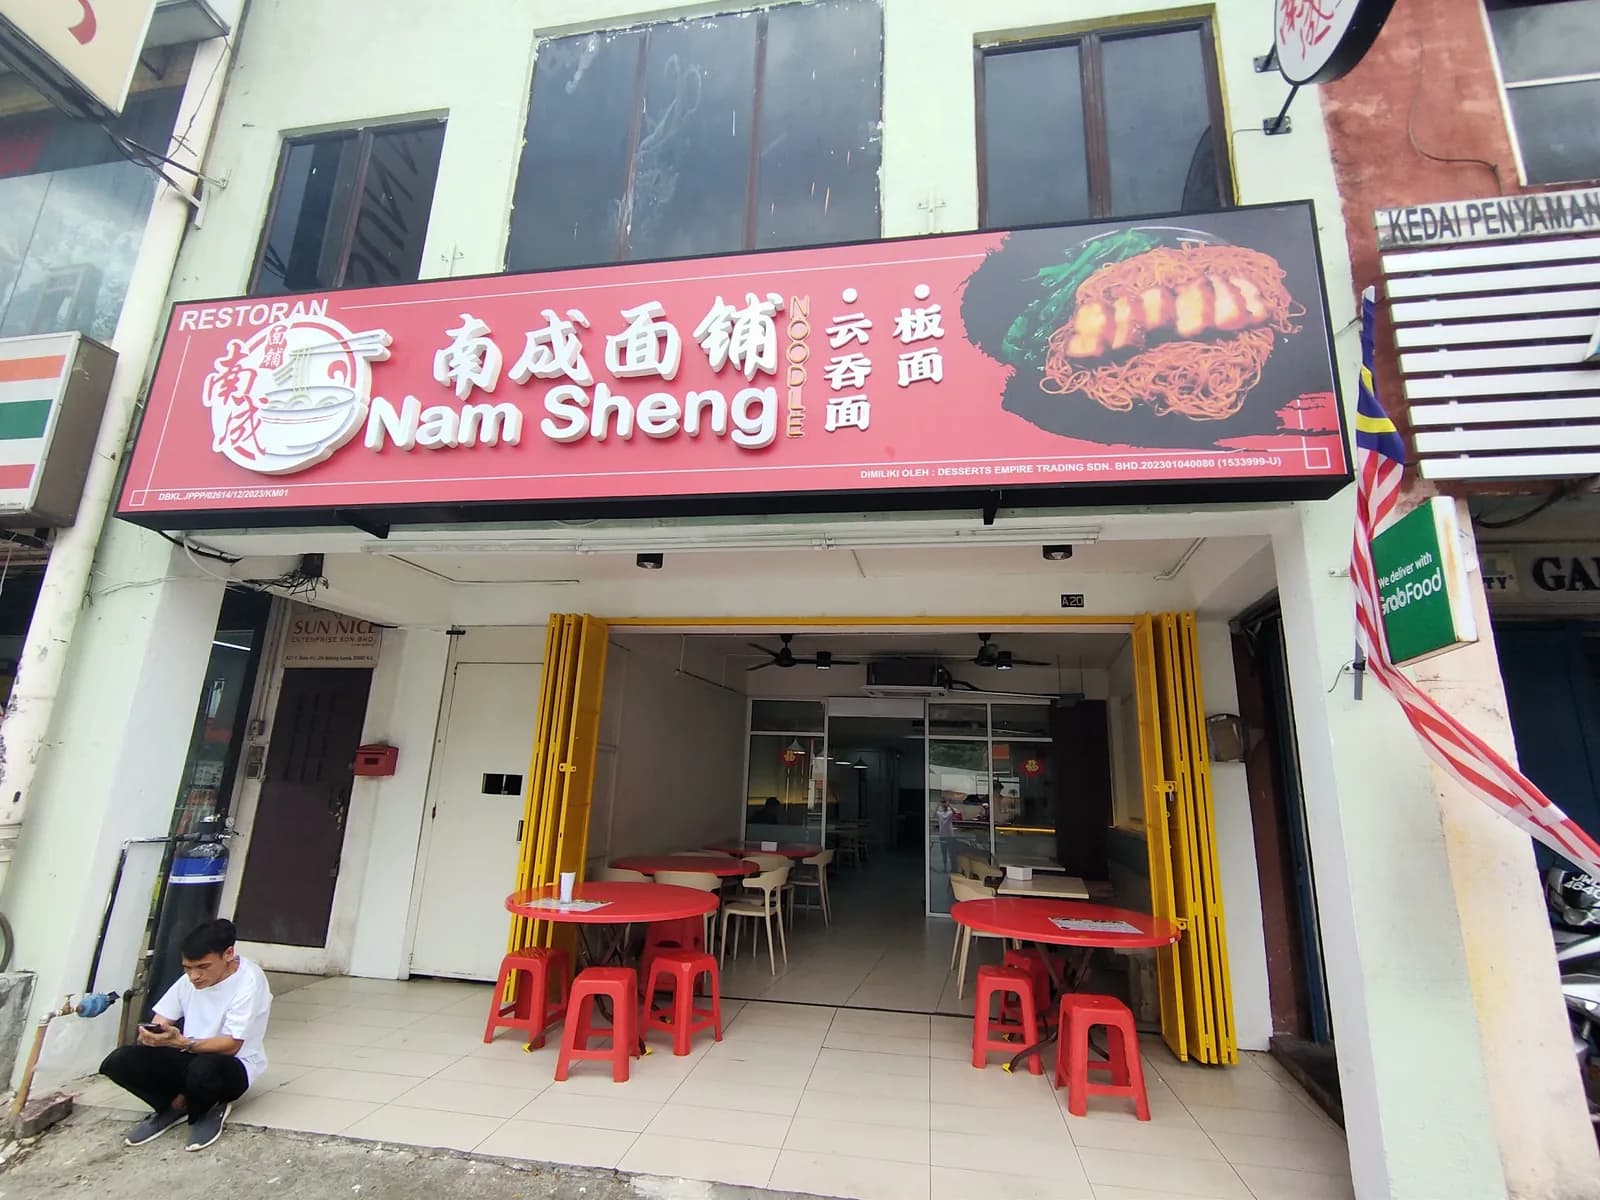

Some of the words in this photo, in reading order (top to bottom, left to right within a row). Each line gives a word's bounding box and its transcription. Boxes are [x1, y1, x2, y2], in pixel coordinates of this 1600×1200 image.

[1389, 205, 1462, 243] KEDAI
[179, 299, 328, 331] RESTORAN
[893, 304, 945, 387] 板面
[787, 296, 810, 438] NOODLE
[824, 312, 872, 432] 云吞面
[364, 395, 523, 453] Nam
[540, 383, 778, 450] Sheng
[860, 469, 900, 479] DIMILIKI
[901, 468, 929, 478] OLEH
[937, 466, 992, 477] DESSERTS
[994, 464, 1033, 475] EMPIRE
[1036, 463, 1084, 473] TRADING
[1086, 462, 1112, 472] SDN.
[1378, 576, 1390, 589] We
[1390, 563, 1414, 583] deliver
[1415, 552, 1432, 569] with
[293, 620, 330, 634] SUN
